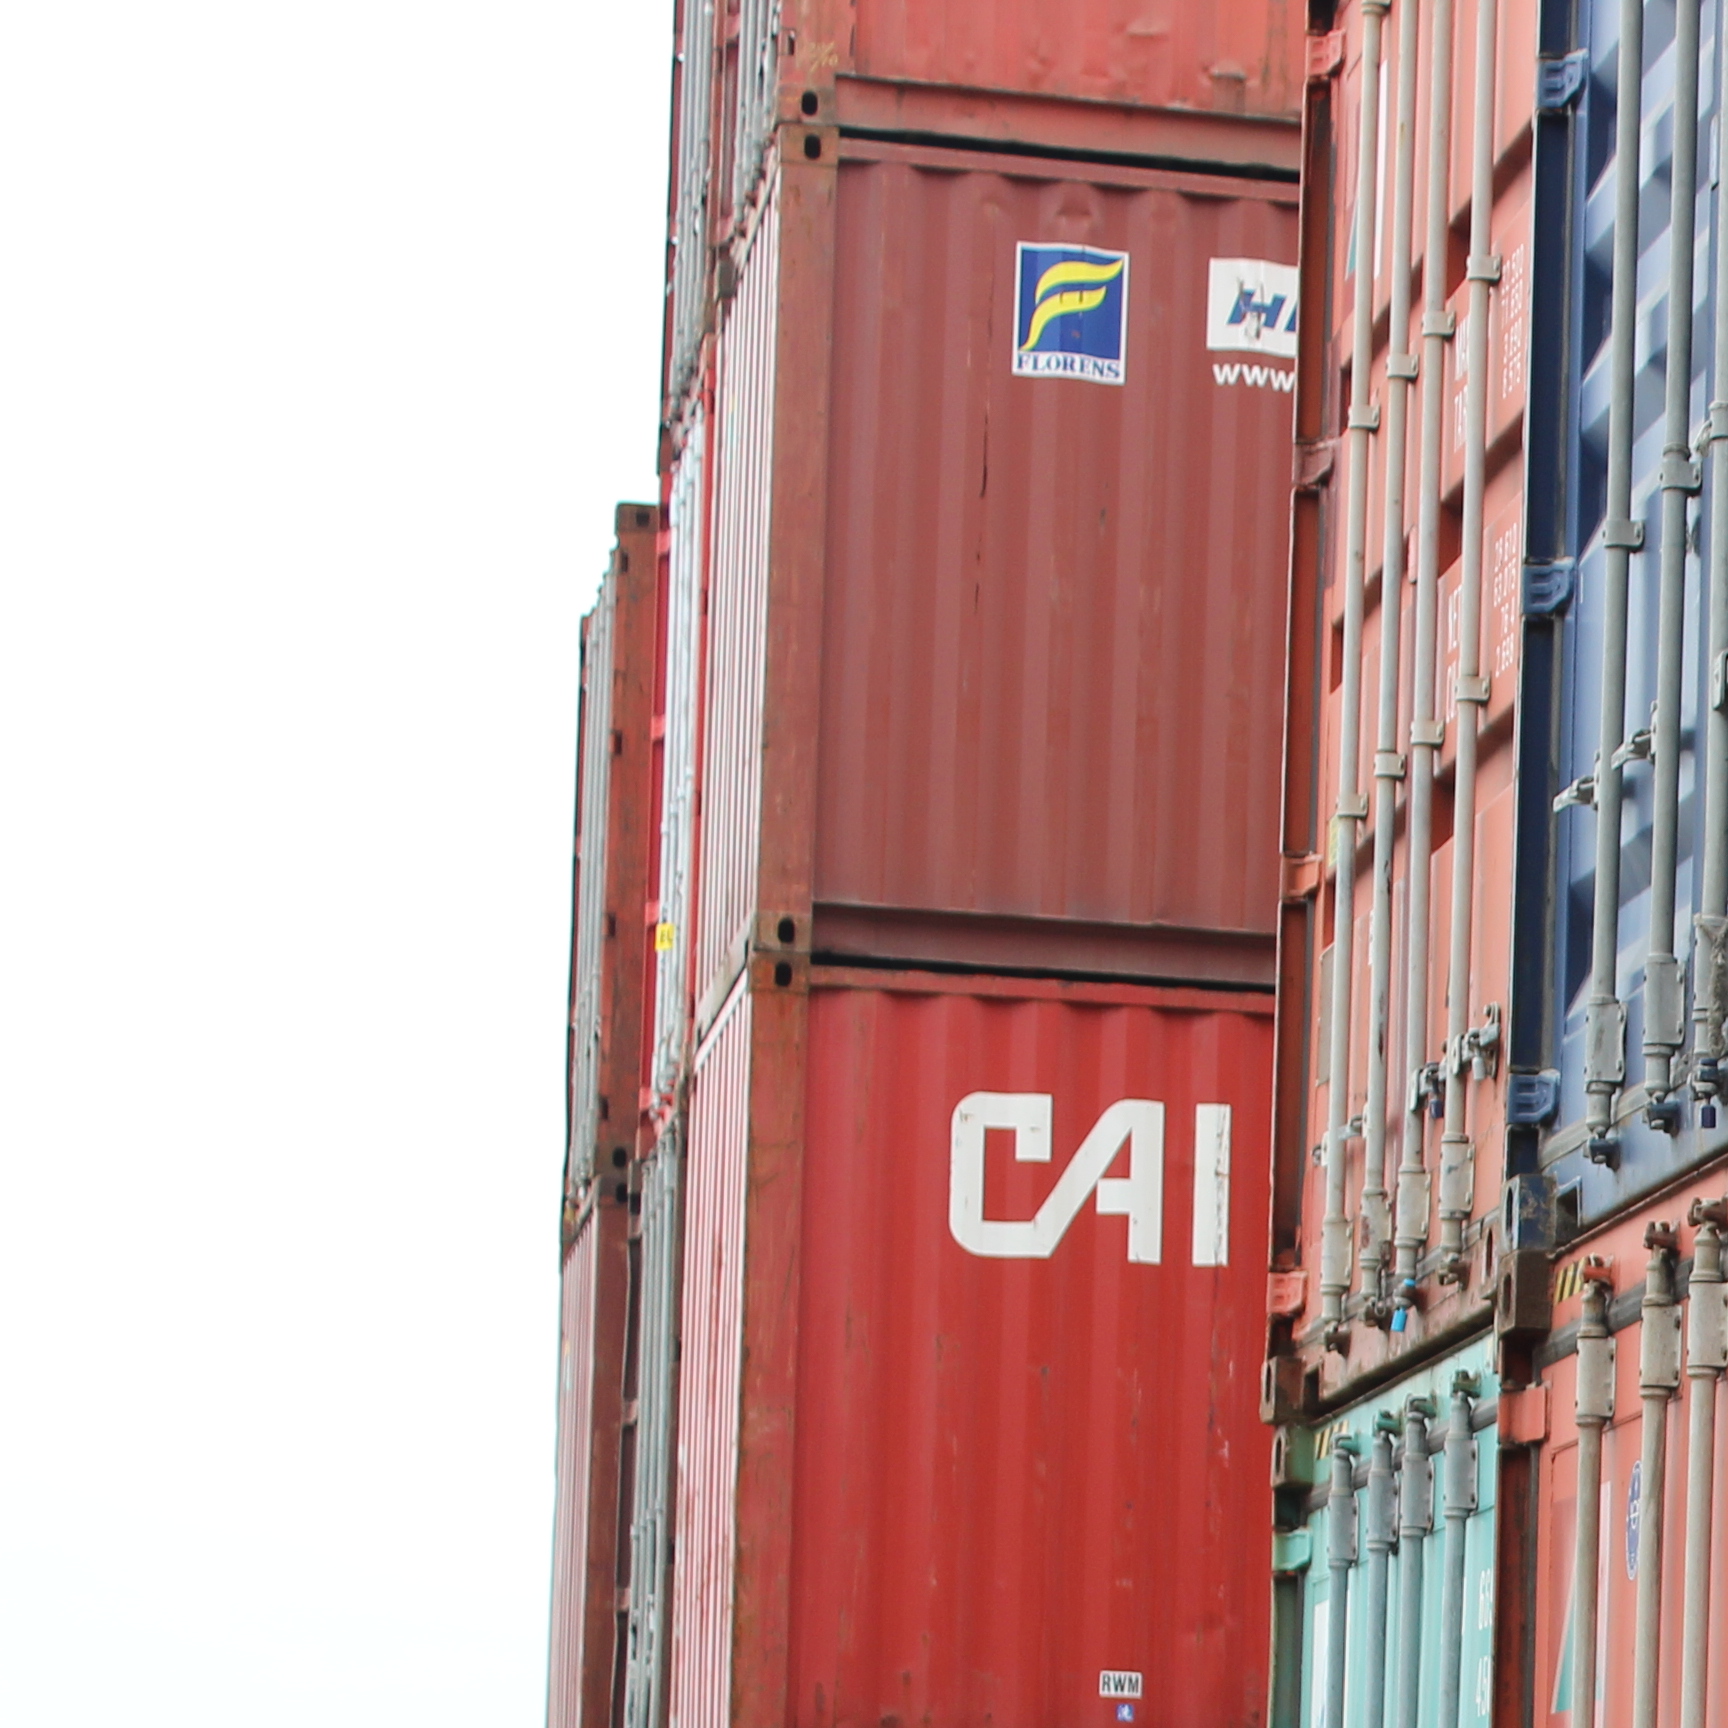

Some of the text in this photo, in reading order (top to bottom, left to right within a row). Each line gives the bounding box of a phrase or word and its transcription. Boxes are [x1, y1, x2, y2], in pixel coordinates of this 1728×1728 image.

[1017, 353, 1120, 379] FLORENS
[949, 1091, 1231, 1267] CAI
[1102, 1674, 1139, 1693] RWM
